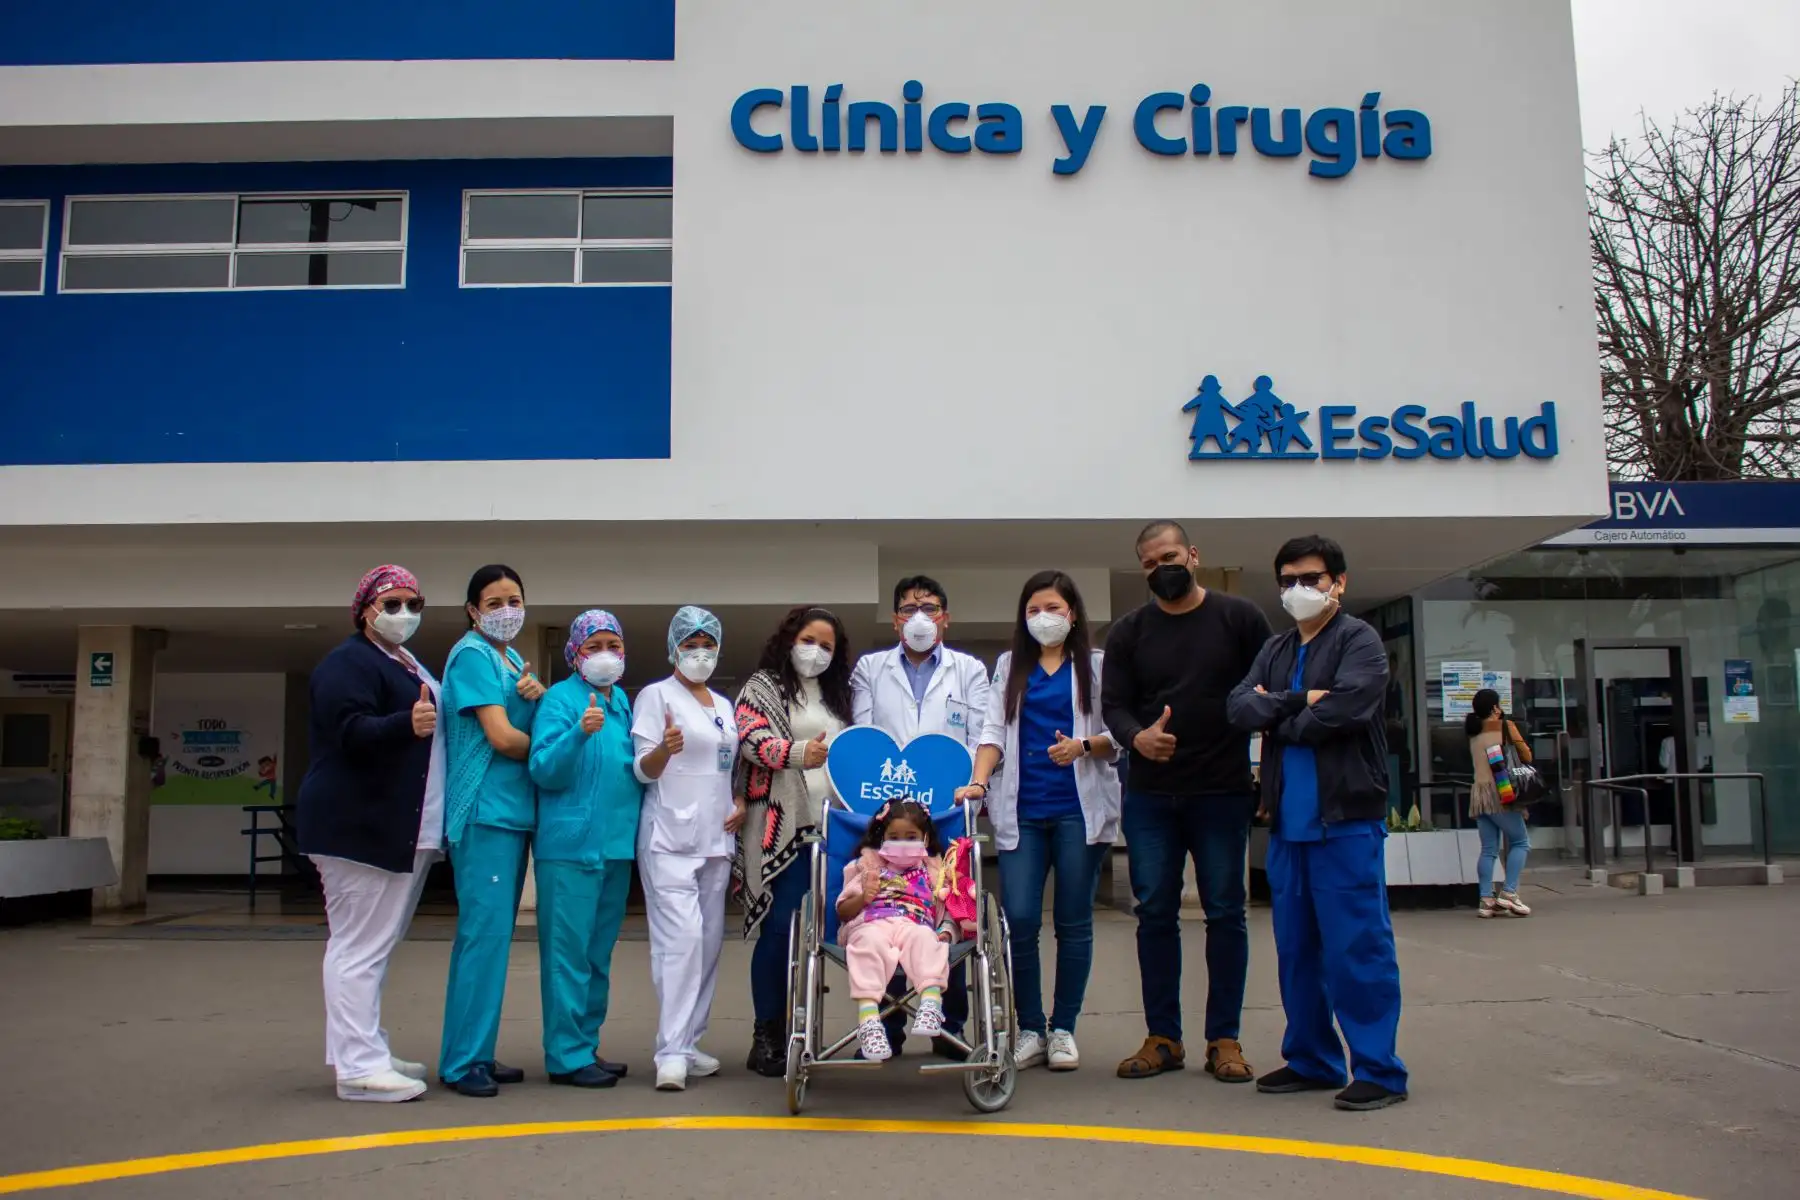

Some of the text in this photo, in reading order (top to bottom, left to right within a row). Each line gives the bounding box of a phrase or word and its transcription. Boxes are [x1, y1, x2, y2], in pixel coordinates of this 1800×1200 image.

[731, 80, 1432, 177] Clínica y Cirugía
[1319, 400, 1559, 460] EsSalud
[1603, 488, 1685, 520] BVA
[1594, 530, 1686, 543] Cajero Automático
[860, 782, 934, 806] EsSalud
